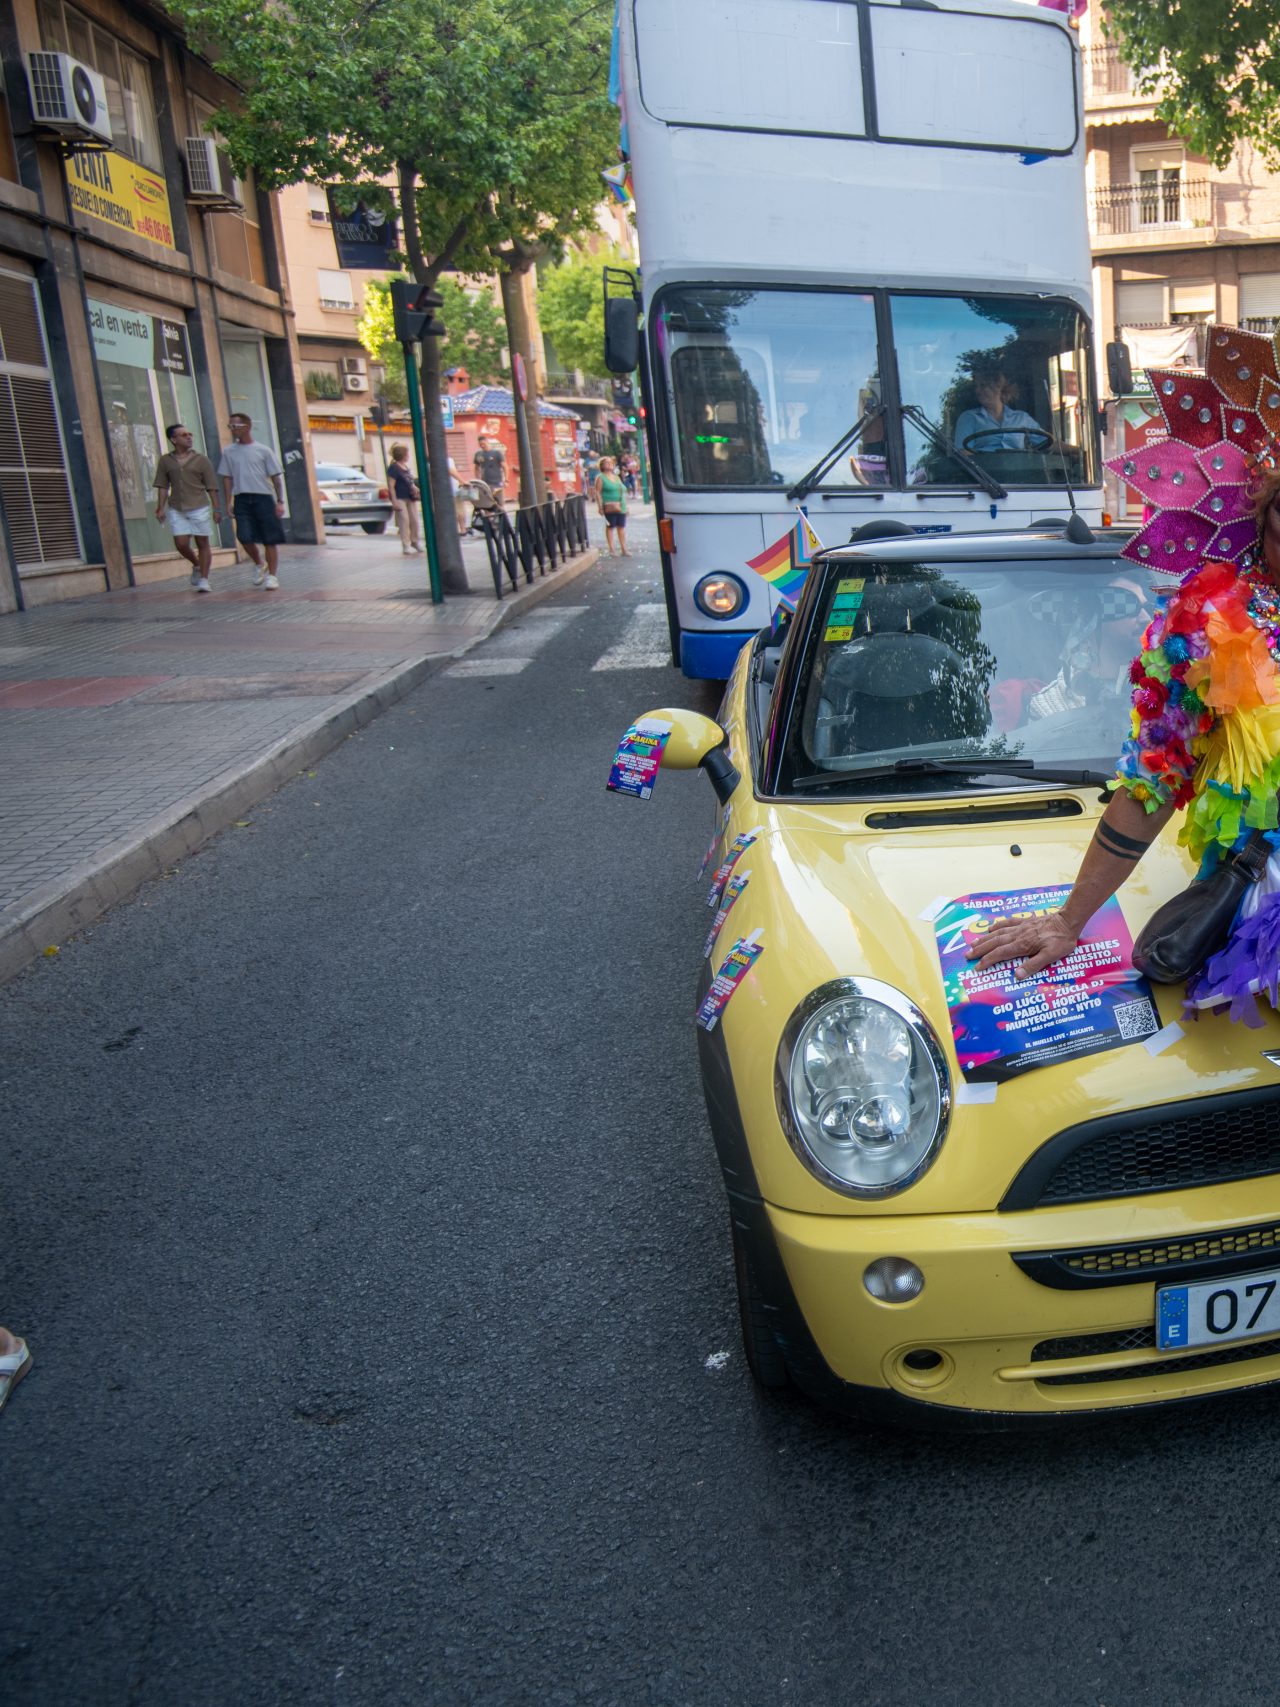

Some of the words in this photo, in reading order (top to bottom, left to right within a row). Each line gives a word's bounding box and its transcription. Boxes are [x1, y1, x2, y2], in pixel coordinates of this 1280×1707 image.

[106, 315, 120, 333] en
[120, 318, 148, 339] venta
[963, 899, 1003, 910] SÁBADO
[1006, 896, 1019, 904] 27
[965, 978, 1011, 995] SOBERBIA
[1057, 961, 1093, 974] MANOLI
[1095, 955, 1121, 966] DIVAY
[970, 970, 1012, 986] CLOVER
[1066, 950, 1111, 964] HUESITO
[1005, 978, 1044, 992] MANOLA
[1046, 970, 1085, 982] VINTAGE
[993, 1002, 1013, 1015] GIO
[1016, 993, 1046, 1009] LUCCI
[1054, 983, 1089, 998] ZUCLA
[1091, 980, 1104, 988] DJ
[1014, 1003, 1049, 1020] PABLO
[1052, 992, 1089, 1008] HORTA
[1006, 1007, 1068, 1032] MUNYEQUITO
[1056, 1014, 1085, 1024] CONFIRMAR
[1032, 1037, 1053, 1046] MUELLE
[1070, 1026, 1094, 1036] ALICANTE
[1168, 1324, 1180, 1338] E
